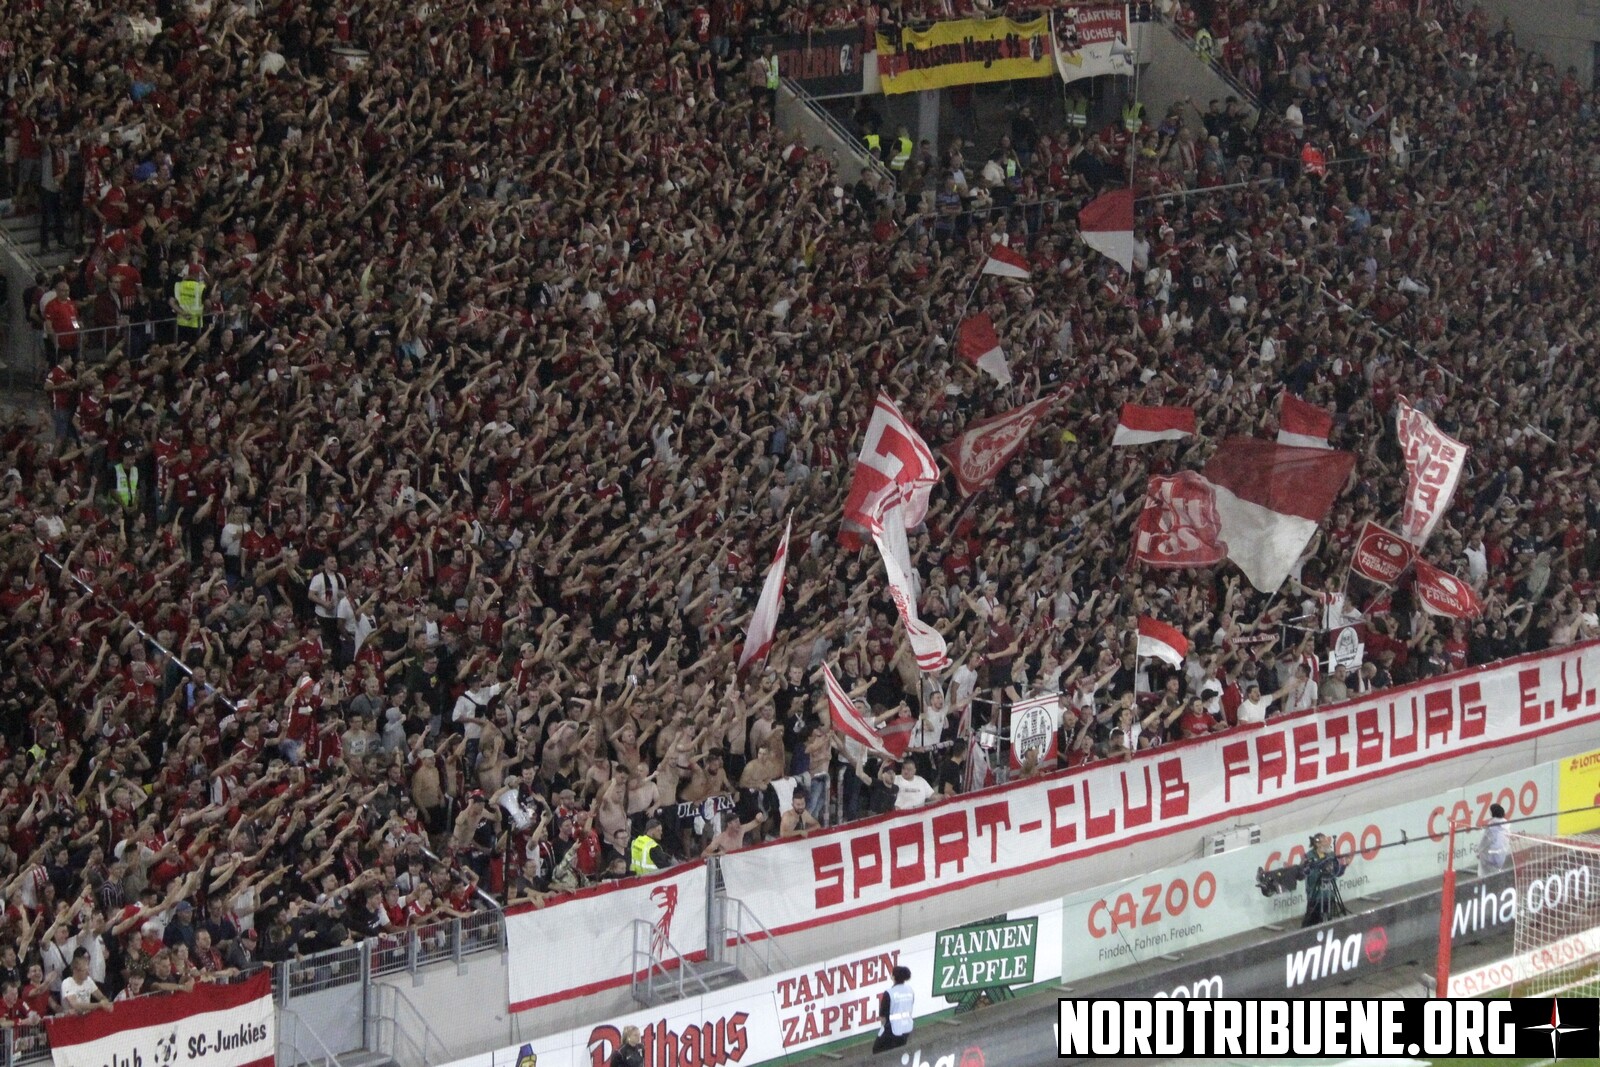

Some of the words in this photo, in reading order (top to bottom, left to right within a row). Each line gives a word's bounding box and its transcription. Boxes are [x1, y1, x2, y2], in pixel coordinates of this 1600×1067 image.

[811, 758, 1190, 909] SPORT-CLUB
[1222, 681, 1487, 803] FREIBURG
[1426, 780, 1539, 842] CAZOO
[1264, 824, 1382, 873] CAOO
[1088, 871, 1217, 939] CAZOO
[1450, 865, 1590, 939] wiha.com
[940, 923, 1034, 958] TANNEN
[1134, 933, 1169, 951] Fahren.
[1170, 922, 1204, 940] Freuen.
[1285, 928, 1363, 988] wiha
[1531, 938, 1586, 971] CAZOO
[777, 949, 901, 1009] TANNEN
[941, 955, 1028, 989] ZÄPFLE
[1453, 965, 1514, 998] CAZOO
[187, 1023, 267, 1059] SC-Junkies
[587, 1011, 750, 1067] Rthaus
